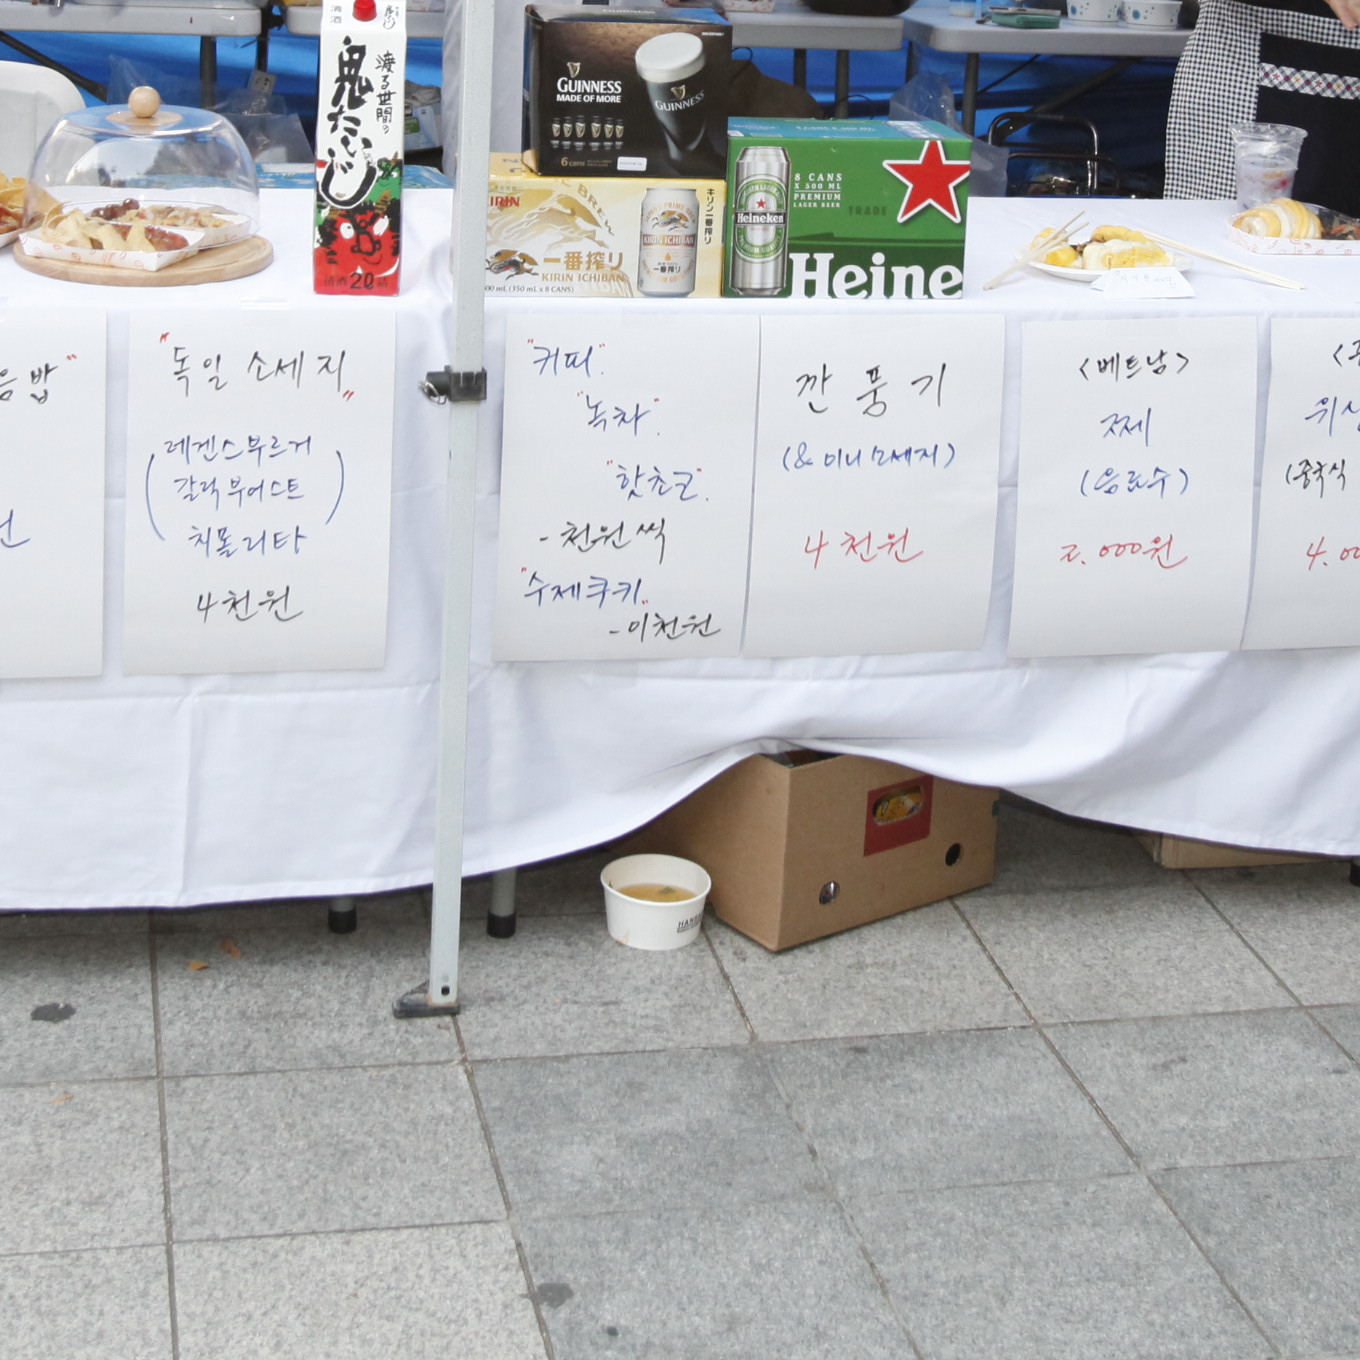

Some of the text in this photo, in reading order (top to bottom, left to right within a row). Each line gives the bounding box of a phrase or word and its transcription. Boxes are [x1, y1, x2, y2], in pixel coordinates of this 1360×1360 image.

[556, 77, 622, 94] GUINNESS
[556, 94, 621, 104] MADE OF MORE
[654, 89, 705, 112] GUINNESS
[560, 157, 568, 167] 6
[569, 159, 585, 168] cans
[794, 173, 843, 182] 8 CANS
[488, 195, 520, 207] IRIN
[793, 193, 842, 201] PREMIUM
[848, 205, 888, 216] TRADE
[736, 212, 785, 225] Heineken
[542, 273, 625, 283] KIRIN ICHIBAN
[789, 252, 964, 300] Heine
[526, 285, 539, 293] mL
[823, 446, 862, 471] 미니
